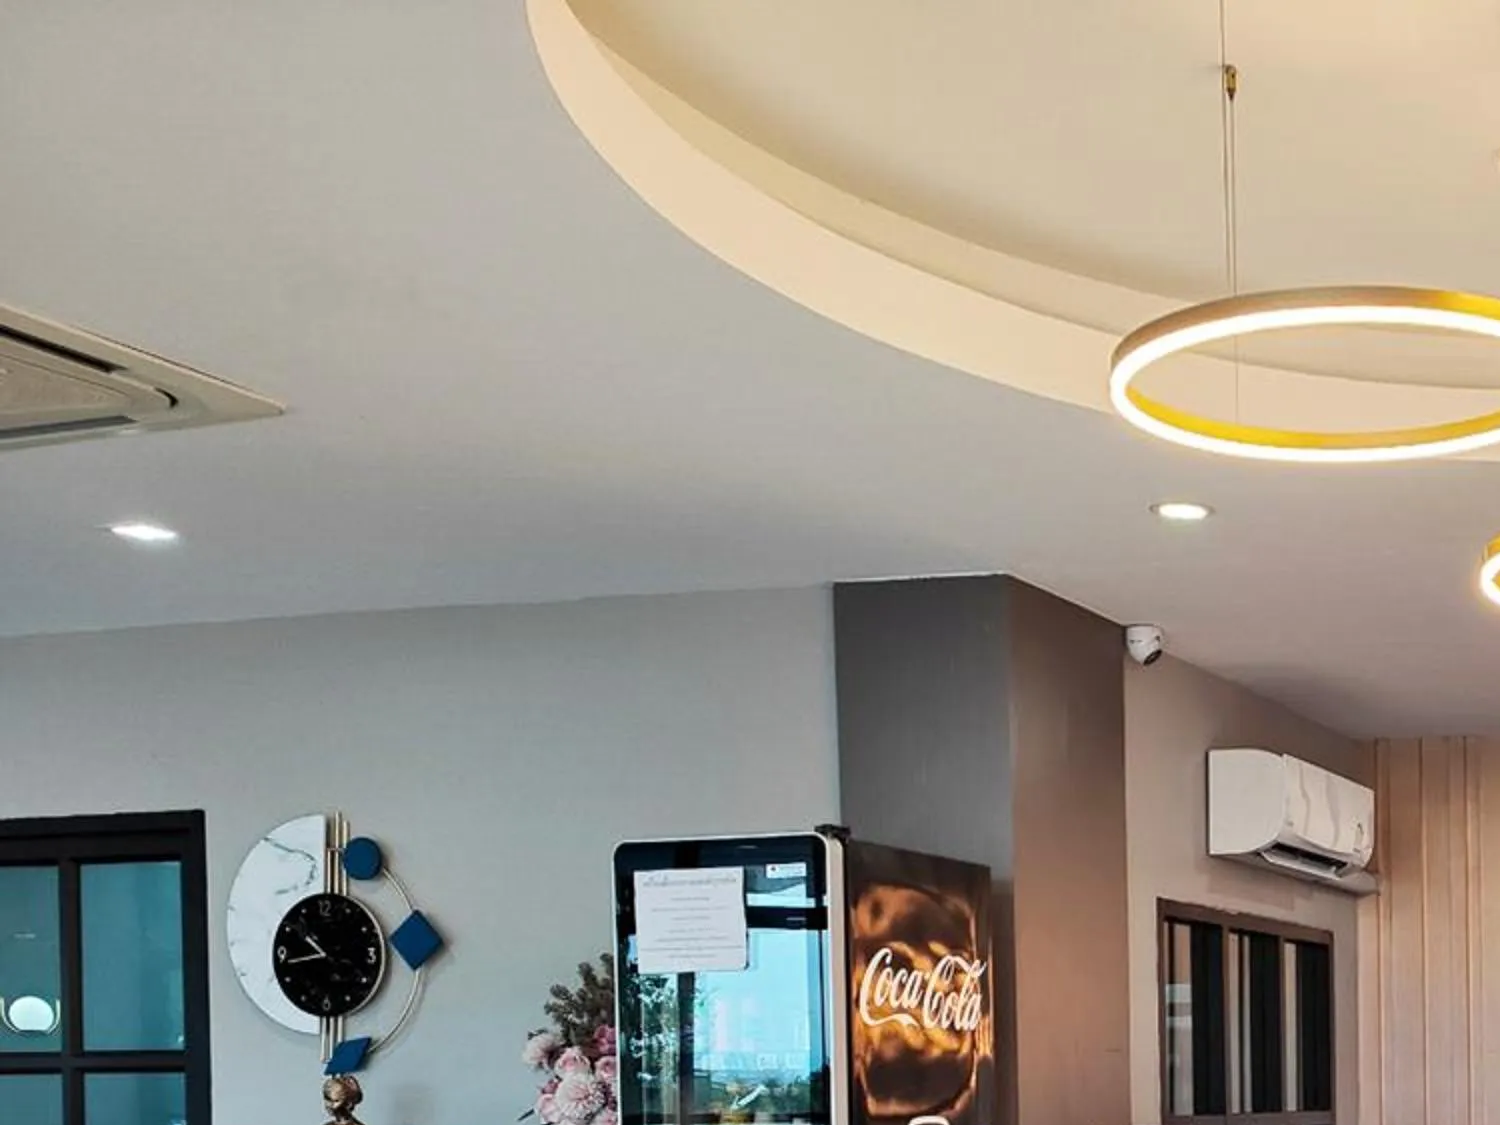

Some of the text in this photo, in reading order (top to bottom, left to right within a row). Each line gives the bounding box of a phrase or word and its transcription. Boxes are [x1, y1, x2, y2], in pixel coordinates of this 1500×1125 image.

[318, 900, 332, 917] 12
[277, 946, 287, 964] 9
[367, 947, 377, 965] 3
